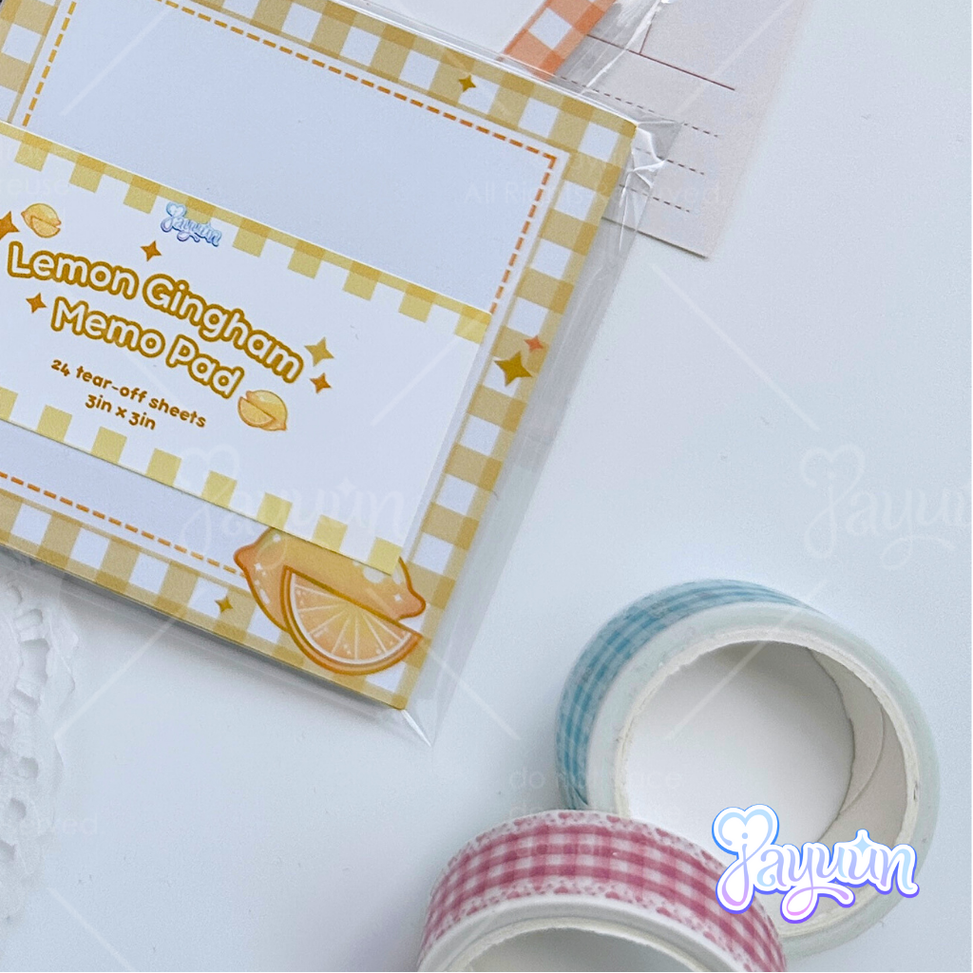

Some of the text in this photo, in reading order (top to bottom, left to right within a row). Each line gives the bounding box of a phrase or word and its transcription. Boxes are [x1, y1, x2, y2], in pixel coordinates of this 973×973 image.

[7, 240, 305, 384] Lemon Gingham
[50, 296, 245, 399] Memo Pad
[50, 358, 207, 429] 24 tear-off sheets
[84, 394, 157, 431] 3in x 3in
